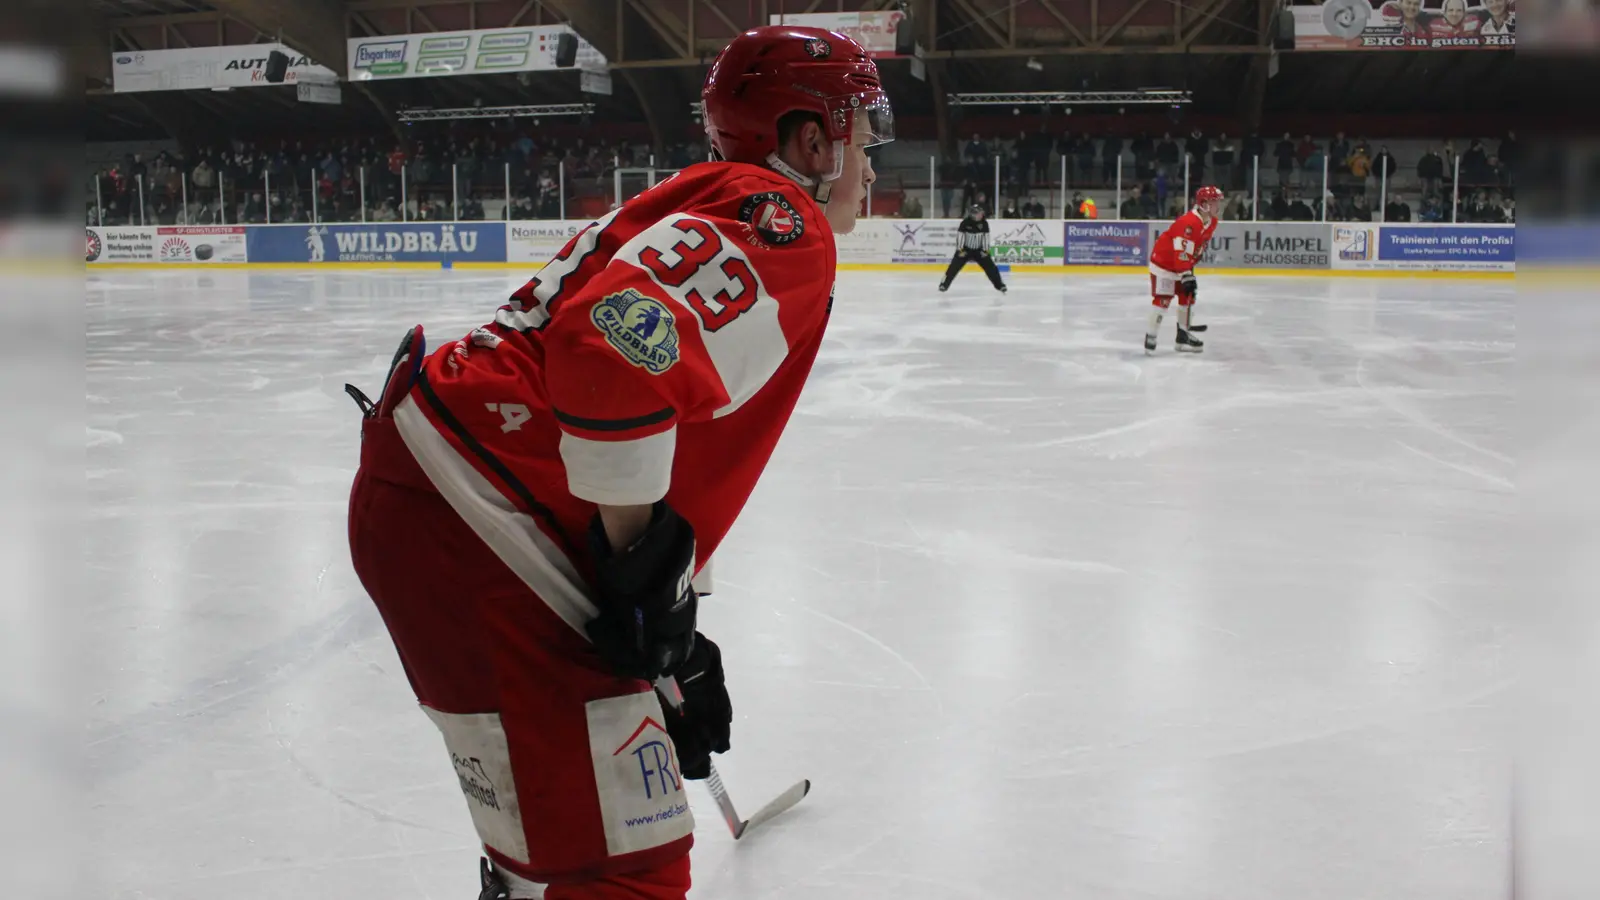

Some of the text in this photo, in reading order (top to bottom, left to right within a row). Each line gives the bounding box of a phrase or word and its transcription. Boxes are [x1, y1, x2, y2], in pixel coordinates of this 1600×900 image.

[1363, 36, 1405, 46] EHC
[1411, 36, 1428, 46] in
[1432, 37, 1480, 48] guten
[512, 227, 564, 237] NORMAN
[335, 225, 478, 252] WILDBRÄU
[1244, 230, 1328, 252] HAMPEL
[1390, 234, 1514, 246] Trainieren mit den Profis!
[170, 248, 182, 257] SF
[994, 247, 1045, 257] LANG
[1244, 254, 1328, 265] SCHLOSSEREI
[638, 218, 759, 333] 33
[602, 309, 668, 364] WILDBRÄU
